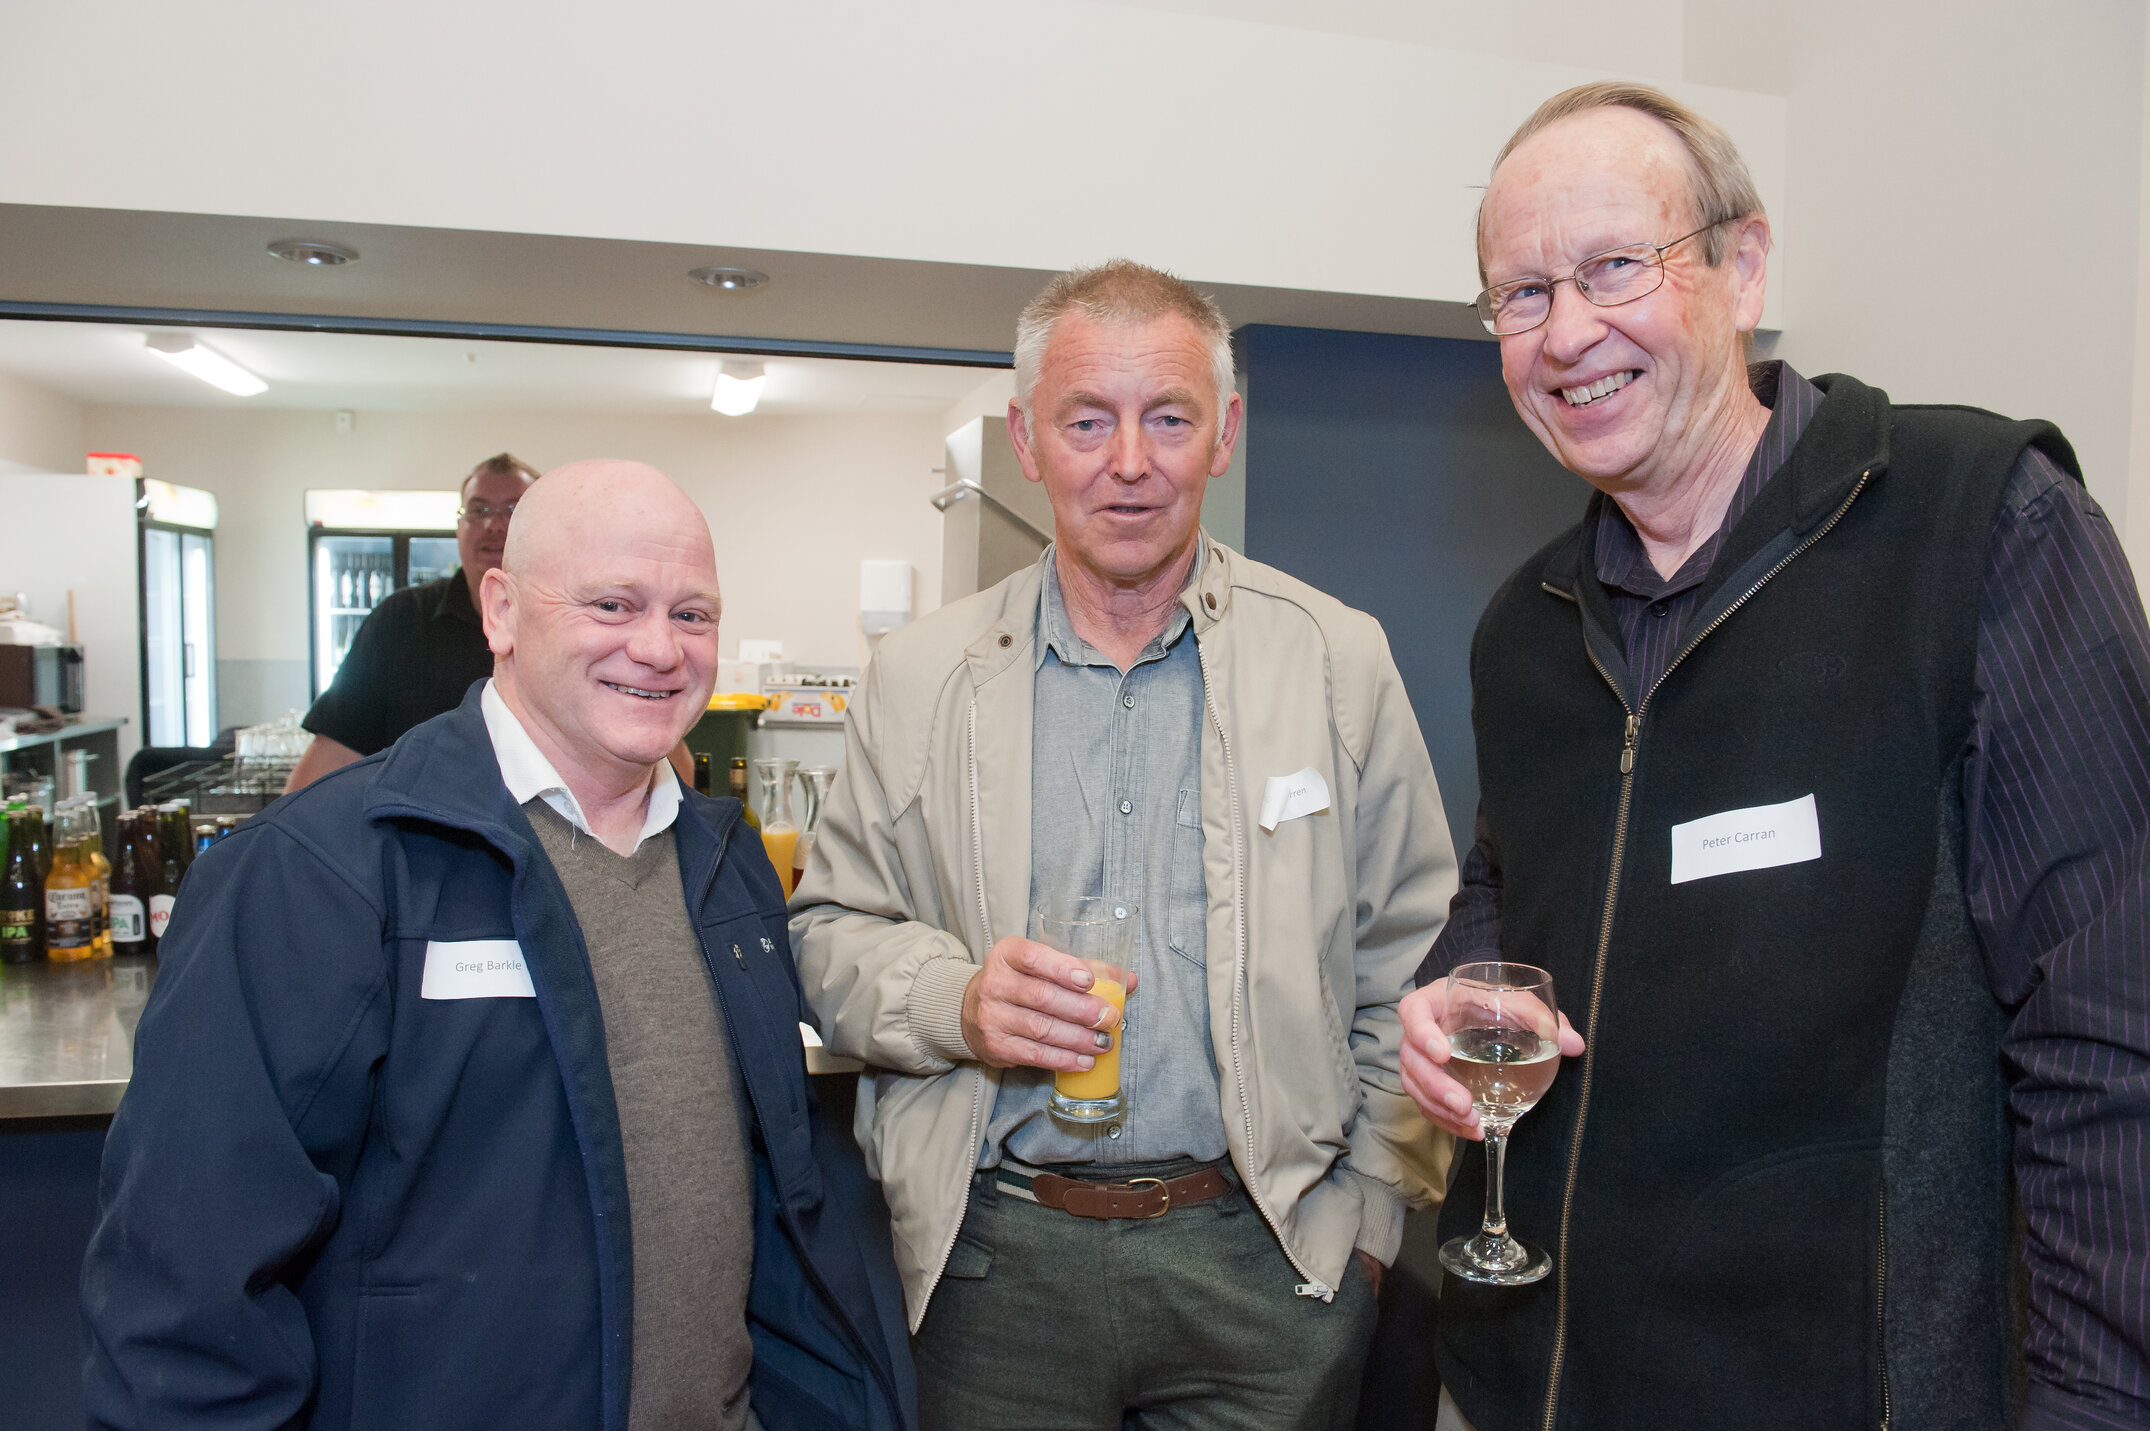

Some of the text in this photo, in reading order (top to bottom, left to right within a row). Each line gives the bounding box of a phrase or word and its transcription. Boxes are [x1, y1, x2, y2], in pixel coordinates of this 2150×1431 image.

[1702, 830, 1776, 849] Peter Carran
[2, 926, 28, 938] IPA
[455, 960, 522, 973] Greg Barkle
